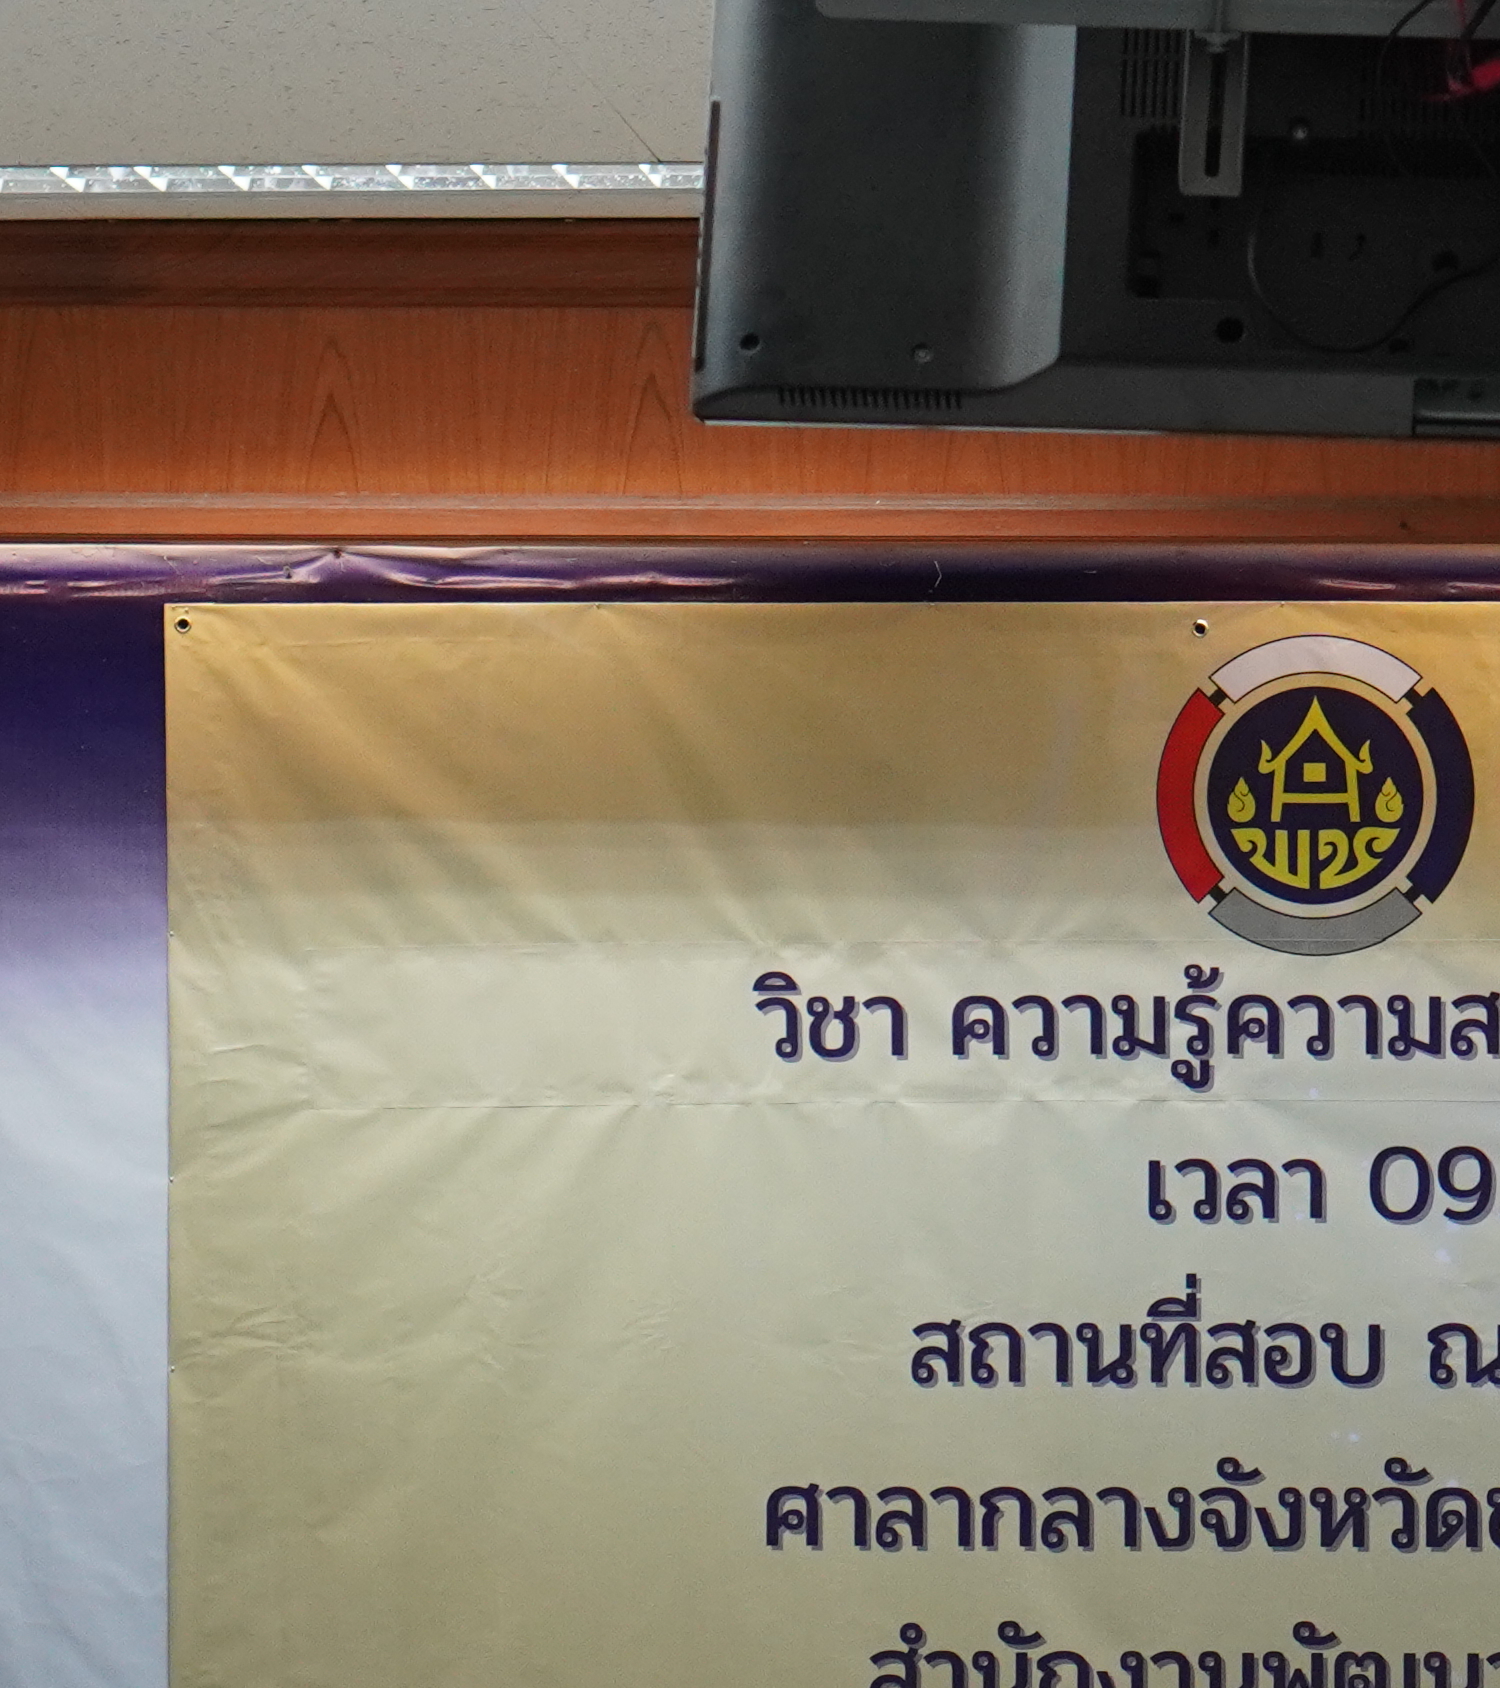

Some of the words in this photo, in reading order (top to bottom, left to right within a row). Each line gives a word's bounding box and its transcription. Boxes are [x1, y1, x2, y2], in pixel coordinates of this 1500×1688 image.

[752, 970, 905, 1060] วิชา
[1147, 1157, 1324, 1222] เวลา
[910, 1272, 1383, 1386] สถานที่สอบ
